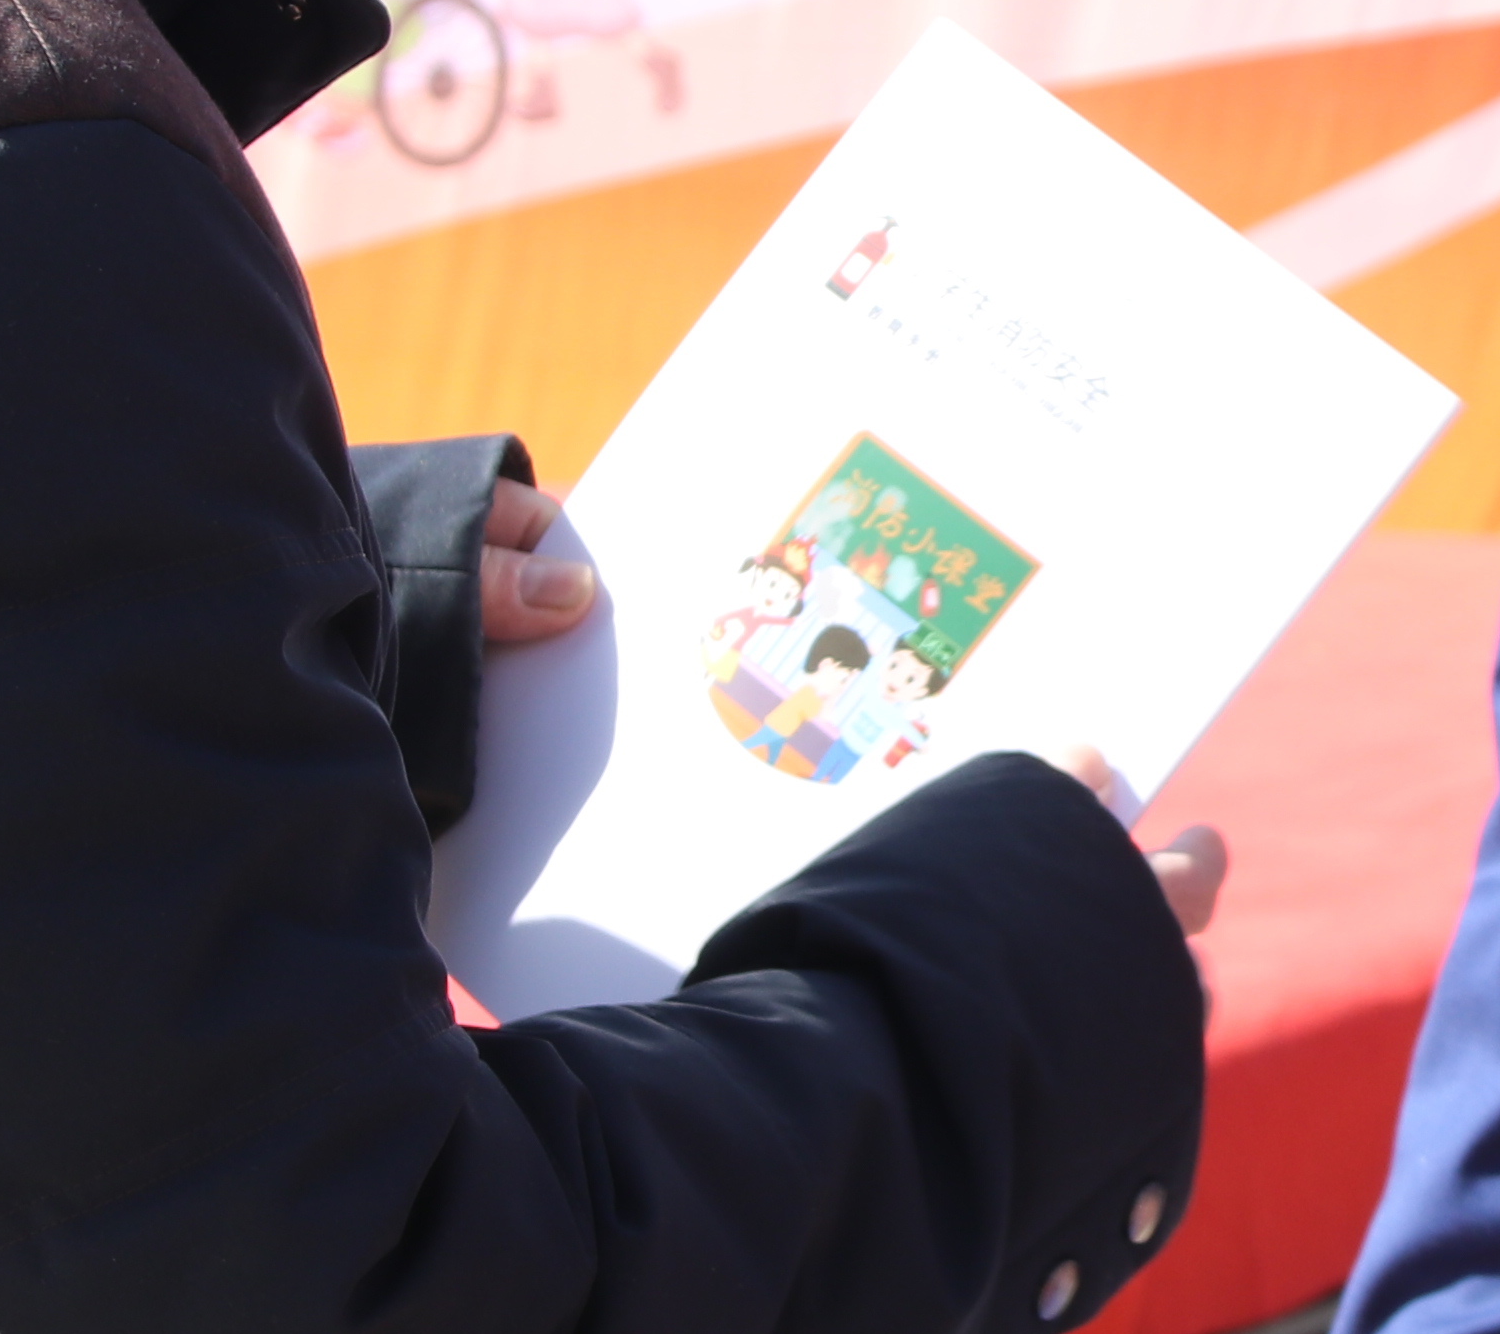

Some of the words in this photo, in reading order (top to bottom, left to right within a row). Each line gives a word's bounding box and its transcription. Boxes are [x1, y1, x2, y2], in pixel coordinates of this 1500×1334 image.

[928, 274, 1112, 415] 学生消防安全
[826, 471, 1007, 614] 消防小课堂
